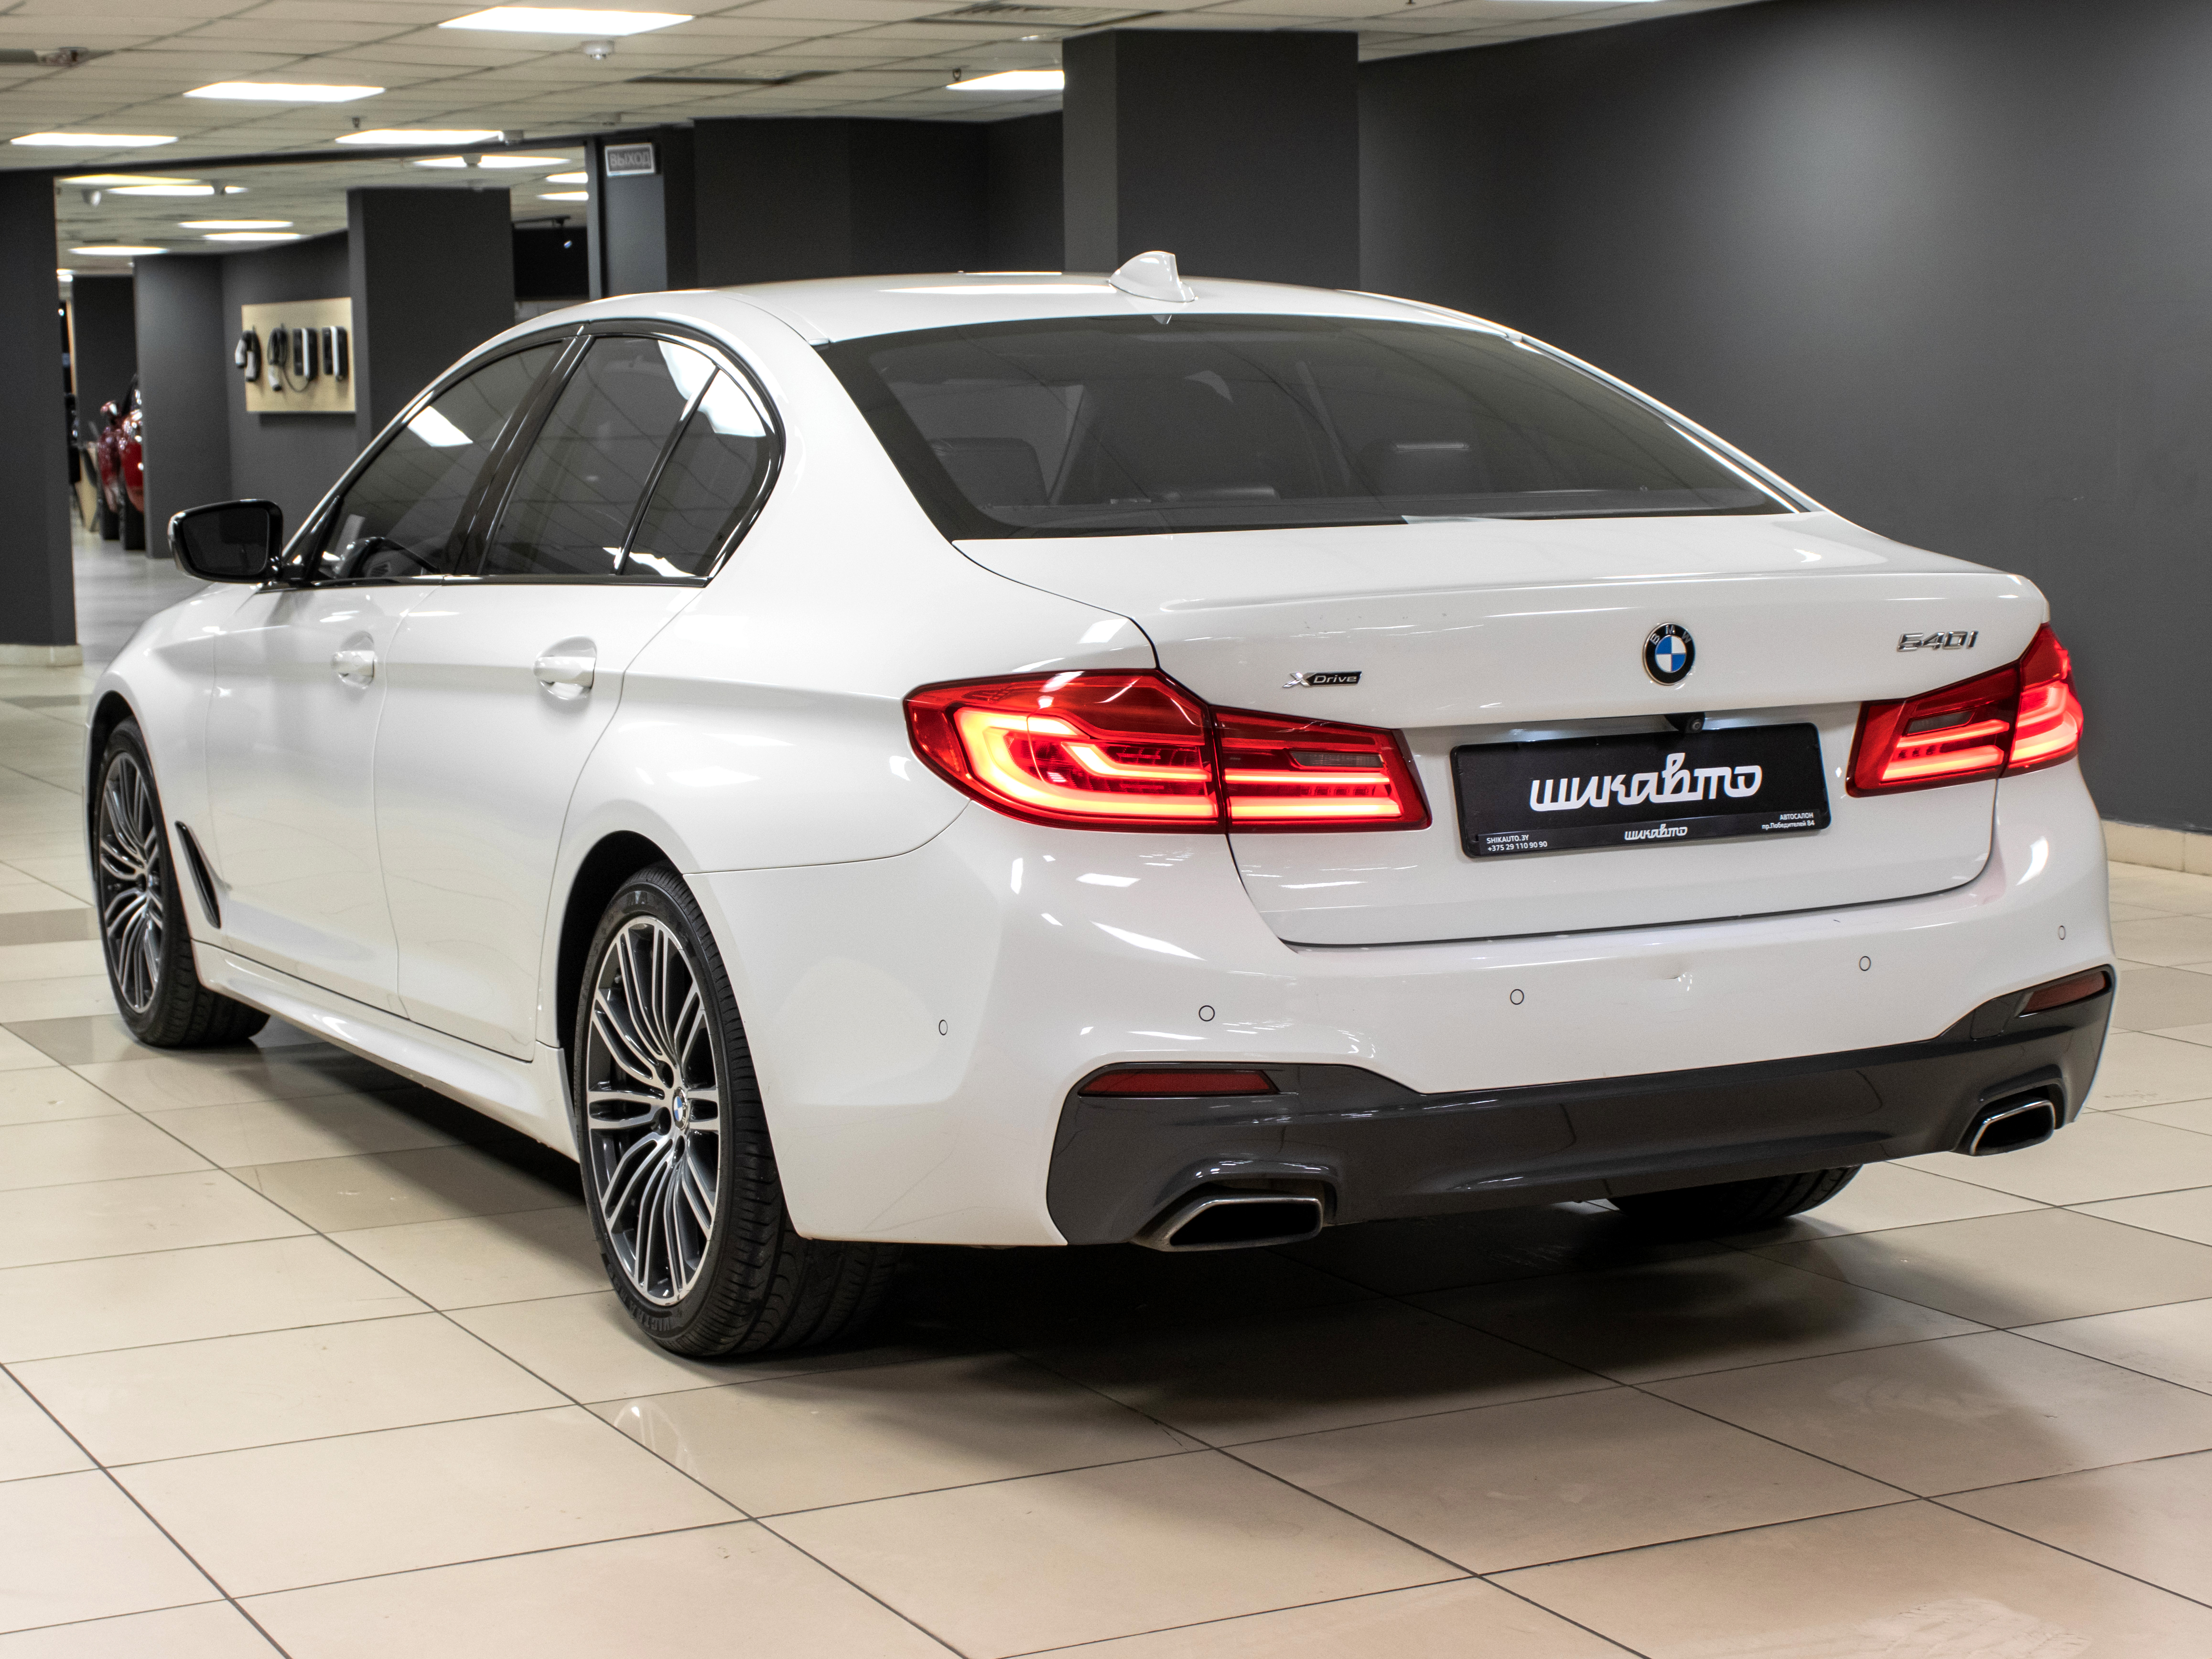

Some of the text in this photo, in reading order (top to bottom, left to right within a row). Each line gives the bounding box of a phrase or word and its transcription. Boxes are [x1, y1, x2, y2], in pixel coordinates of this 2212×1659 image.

[610, 152, 651, 167] ВЫХОД
[1649, 625, 1692, 646] BMW
[1896, 631, 1979, 652] 540i
